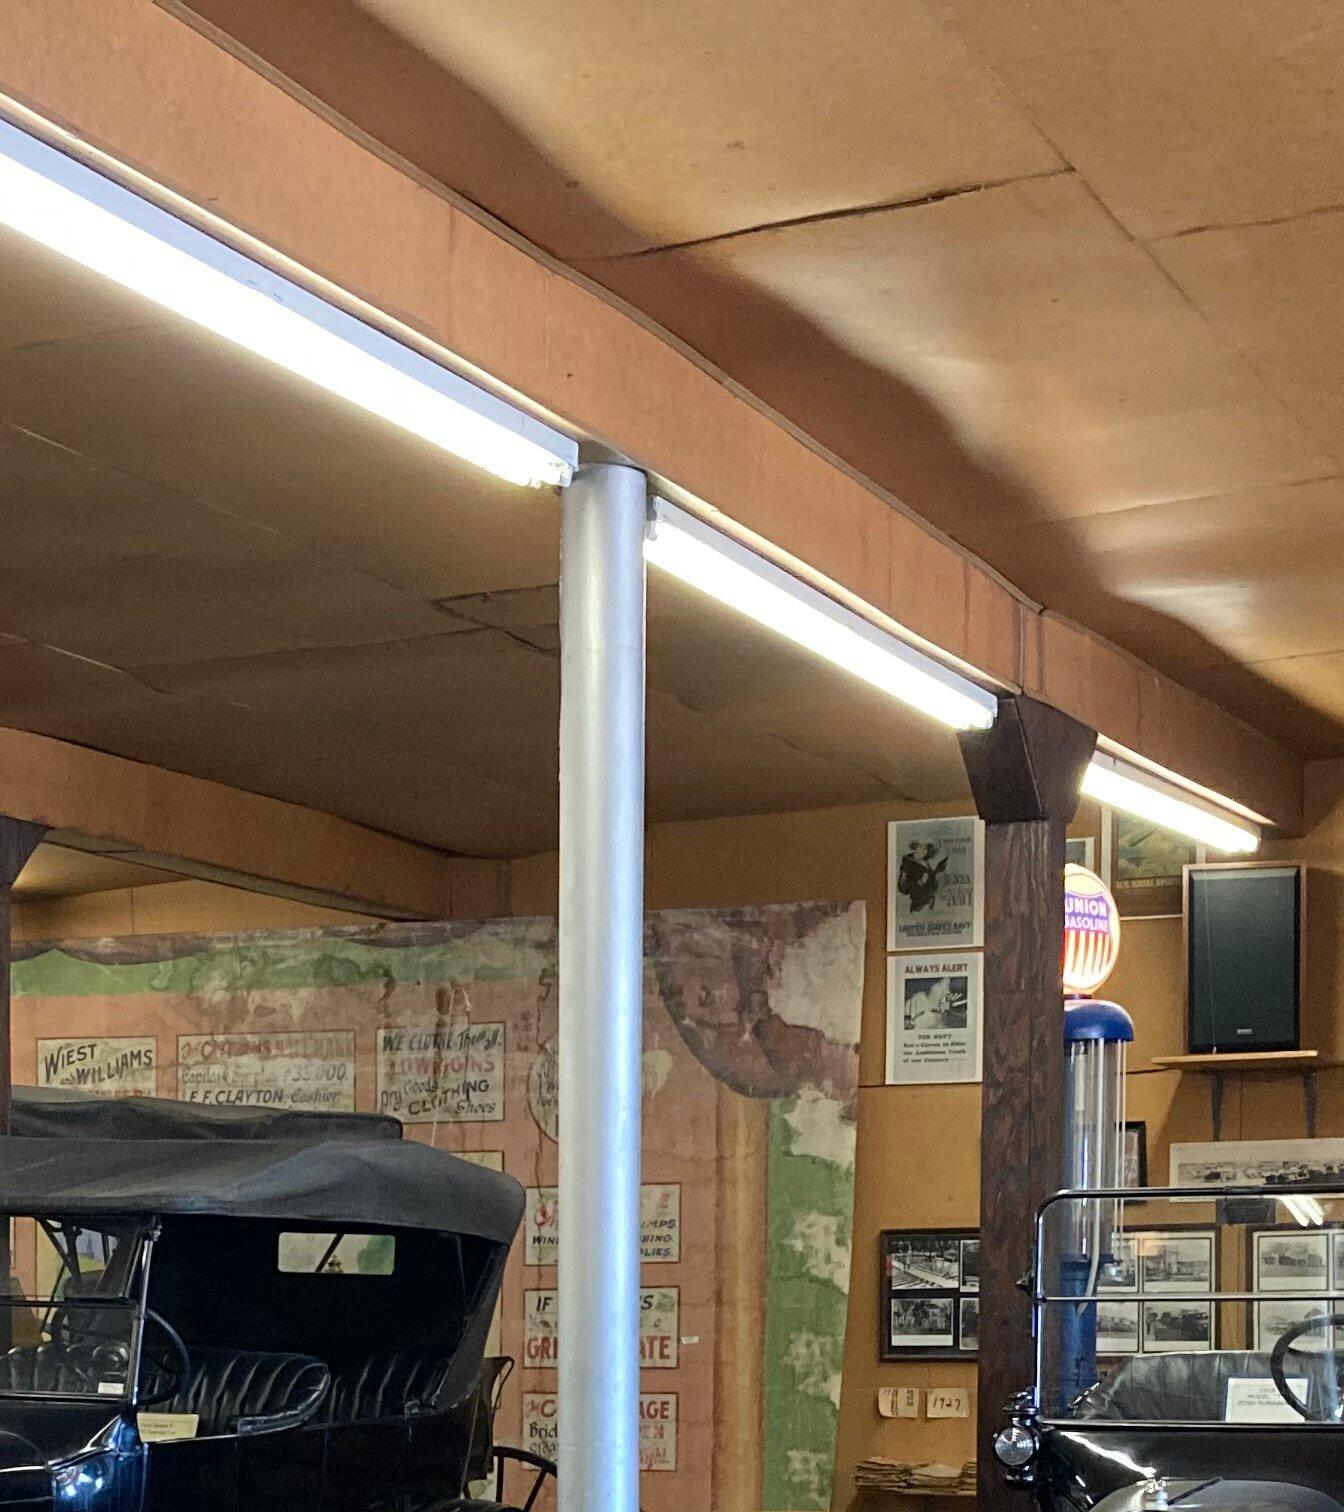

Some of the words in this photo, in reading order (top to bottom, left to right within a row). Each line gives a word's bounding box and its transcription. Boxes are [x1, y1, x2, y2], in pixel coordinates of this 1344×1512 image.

[1064, 896, 1108, 918] UNION
[905, 965, 940, 974] ALWAYS
[941, 963, 969, 973] ALERT
[382, 1033, 404, 1053] WE
[44, 1043, 98, 1078] WIEST
[75, 1049, 153, 1085] WILLIAMS
[408, 1079, 490, 1116] CLOTHING
[455, 1099, 496, 1115] Shoes
[535, 1295, 554, 1312] IF
[932, 1396, 962, 1411] 1927
